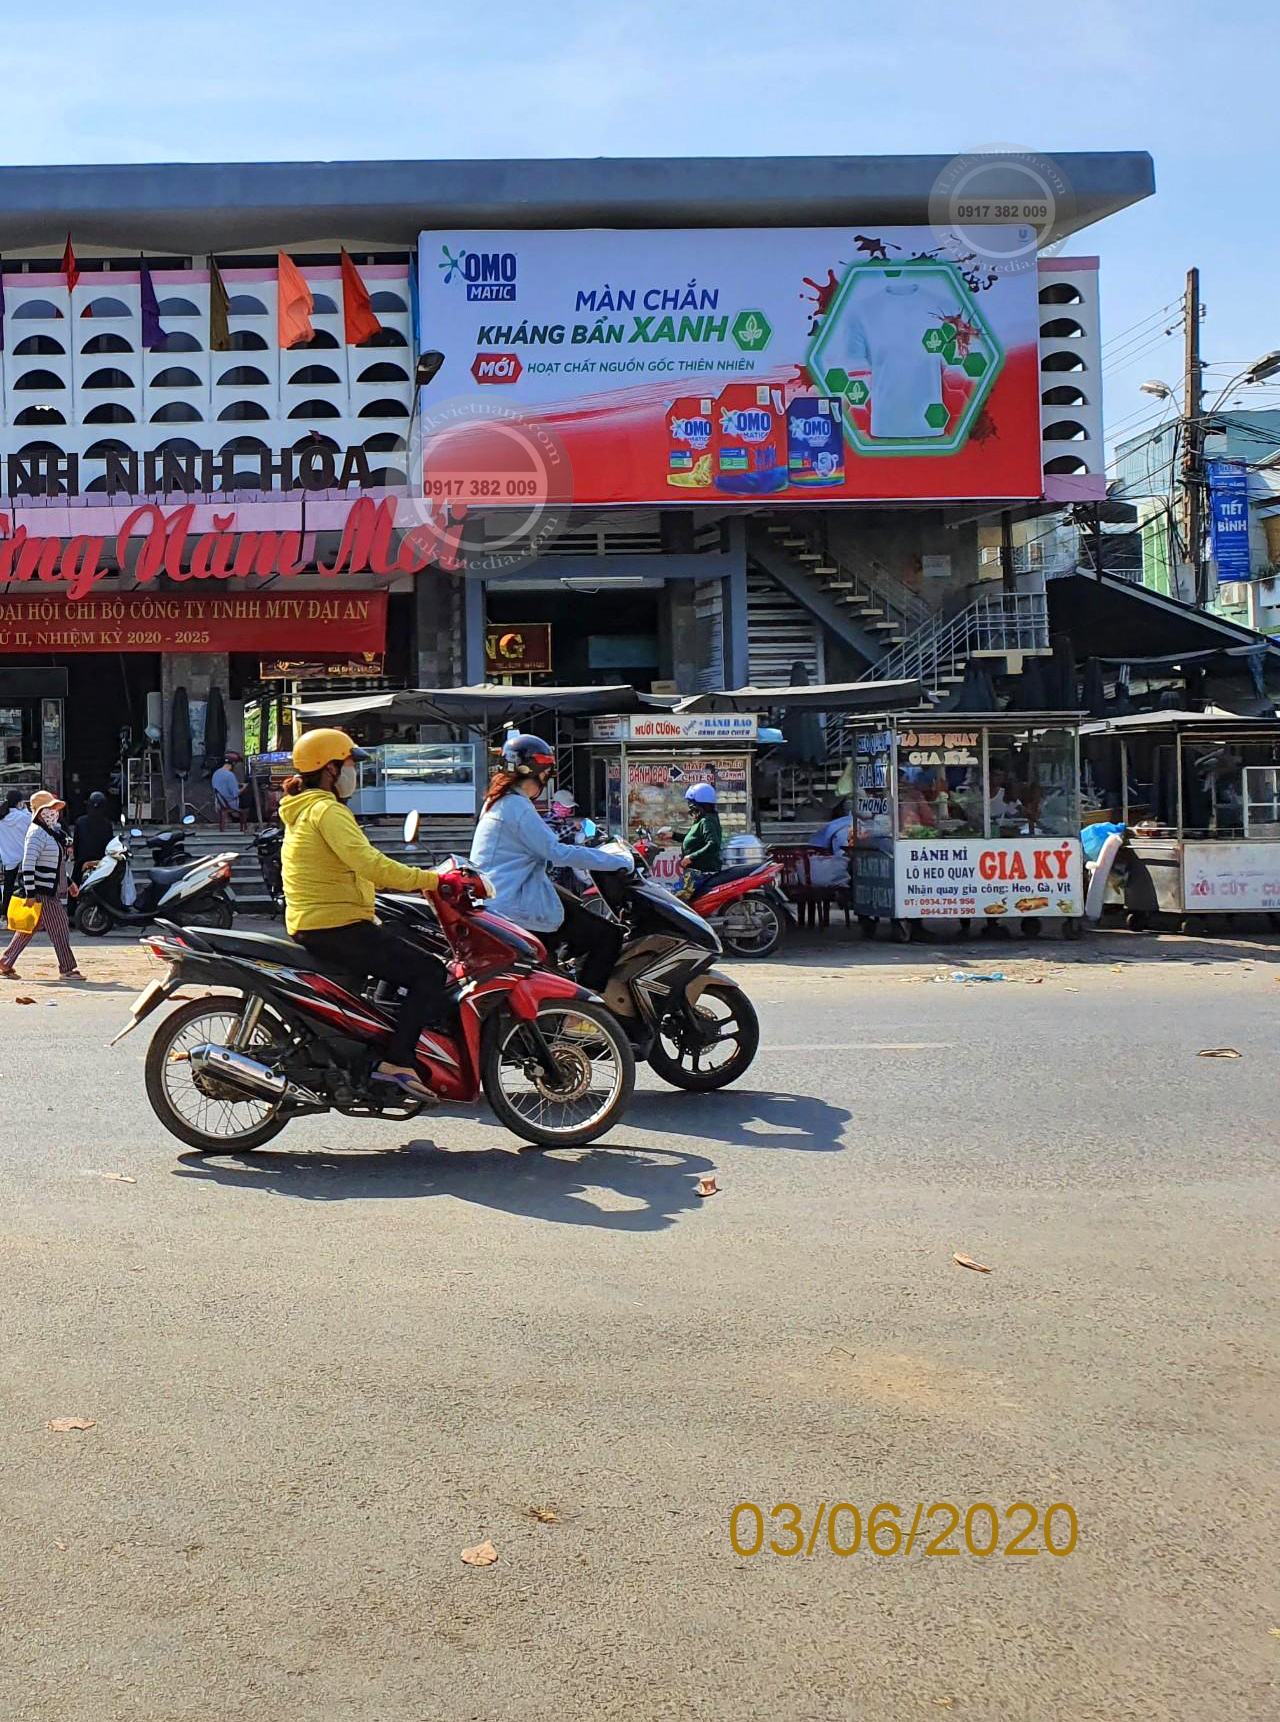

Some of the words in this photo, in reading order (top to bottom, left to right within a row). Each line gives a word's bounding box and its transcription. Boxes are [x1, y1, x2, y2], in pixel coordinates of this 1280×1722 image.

[465, 253, 517, 282] OMO
[470, 285, 512, 299] MATIC
[575, 284, 636, 312] MÀN
[643, 278, 720, 311] CHẮN
[477, 320, 565, 345] KHÁNG
[570, 315, 625, 344] BẨN
[628, 315, 729, 343] XANH
[477, 357, 516, 378] MỚI
[527, 362, 560, 376] HOẠT
[564, 359, 597, 373] CHẤT
[647, 357, 675, 372] GỐC
[678, 359, 714, 371] THIÊN
[717, 358, 755, 371] NHIÊN
[684, 421, 712, 436] OMO
[737, 413, 770, 431] OMO
[803, 421, 830, 436] OMO
[106, 448, 235, 496] NINH
[260, 430, 374, 491] HÒA
[1217, 518, 1247, 532] BÌNH
[116, 503, 308, 583] Năm
[317, 495, 468, 577] Mới
[27, 599, 59, 626] HỘI
[65, 602, 96, 620] CHI
[101, 597, 125, 624] BỘ
[130, 597, 179, 620] CÔNG
[184, 600, 206, 618] TY
[211, 600, 261, 619] TNHH
[265, 600, 304, 619] MTV
[307, 600, 339, 624] ĐẠI
[342, 600, 369, 619] AN
[15, 631, 33, 647] II,
[36, 629, 96, 647] NHIỆM
[127, 631, 162, 644] 2020
[175, 631, 210, 644] 2025
[944, 733, 979, 748] QUAY
[911, 847, 949, 861] BÁNH
[952, 846, 968, 861] MÌ
[979, 850, 1027, 880] GIA
[1033, 841, 1072, 880] KÝ
[906, 865, 920, 879] LÒ
[923, 867, 945, 879] HEO
[948, 866, 975, 880] QUAY
[907, 884, 933, 897] Nhận
[936, 885, 959, 896] quay
[962, 884, 978, 895] gia
[981, 883, 1009, 896] công:
[1057, 882, 1072, 895] Vịt
